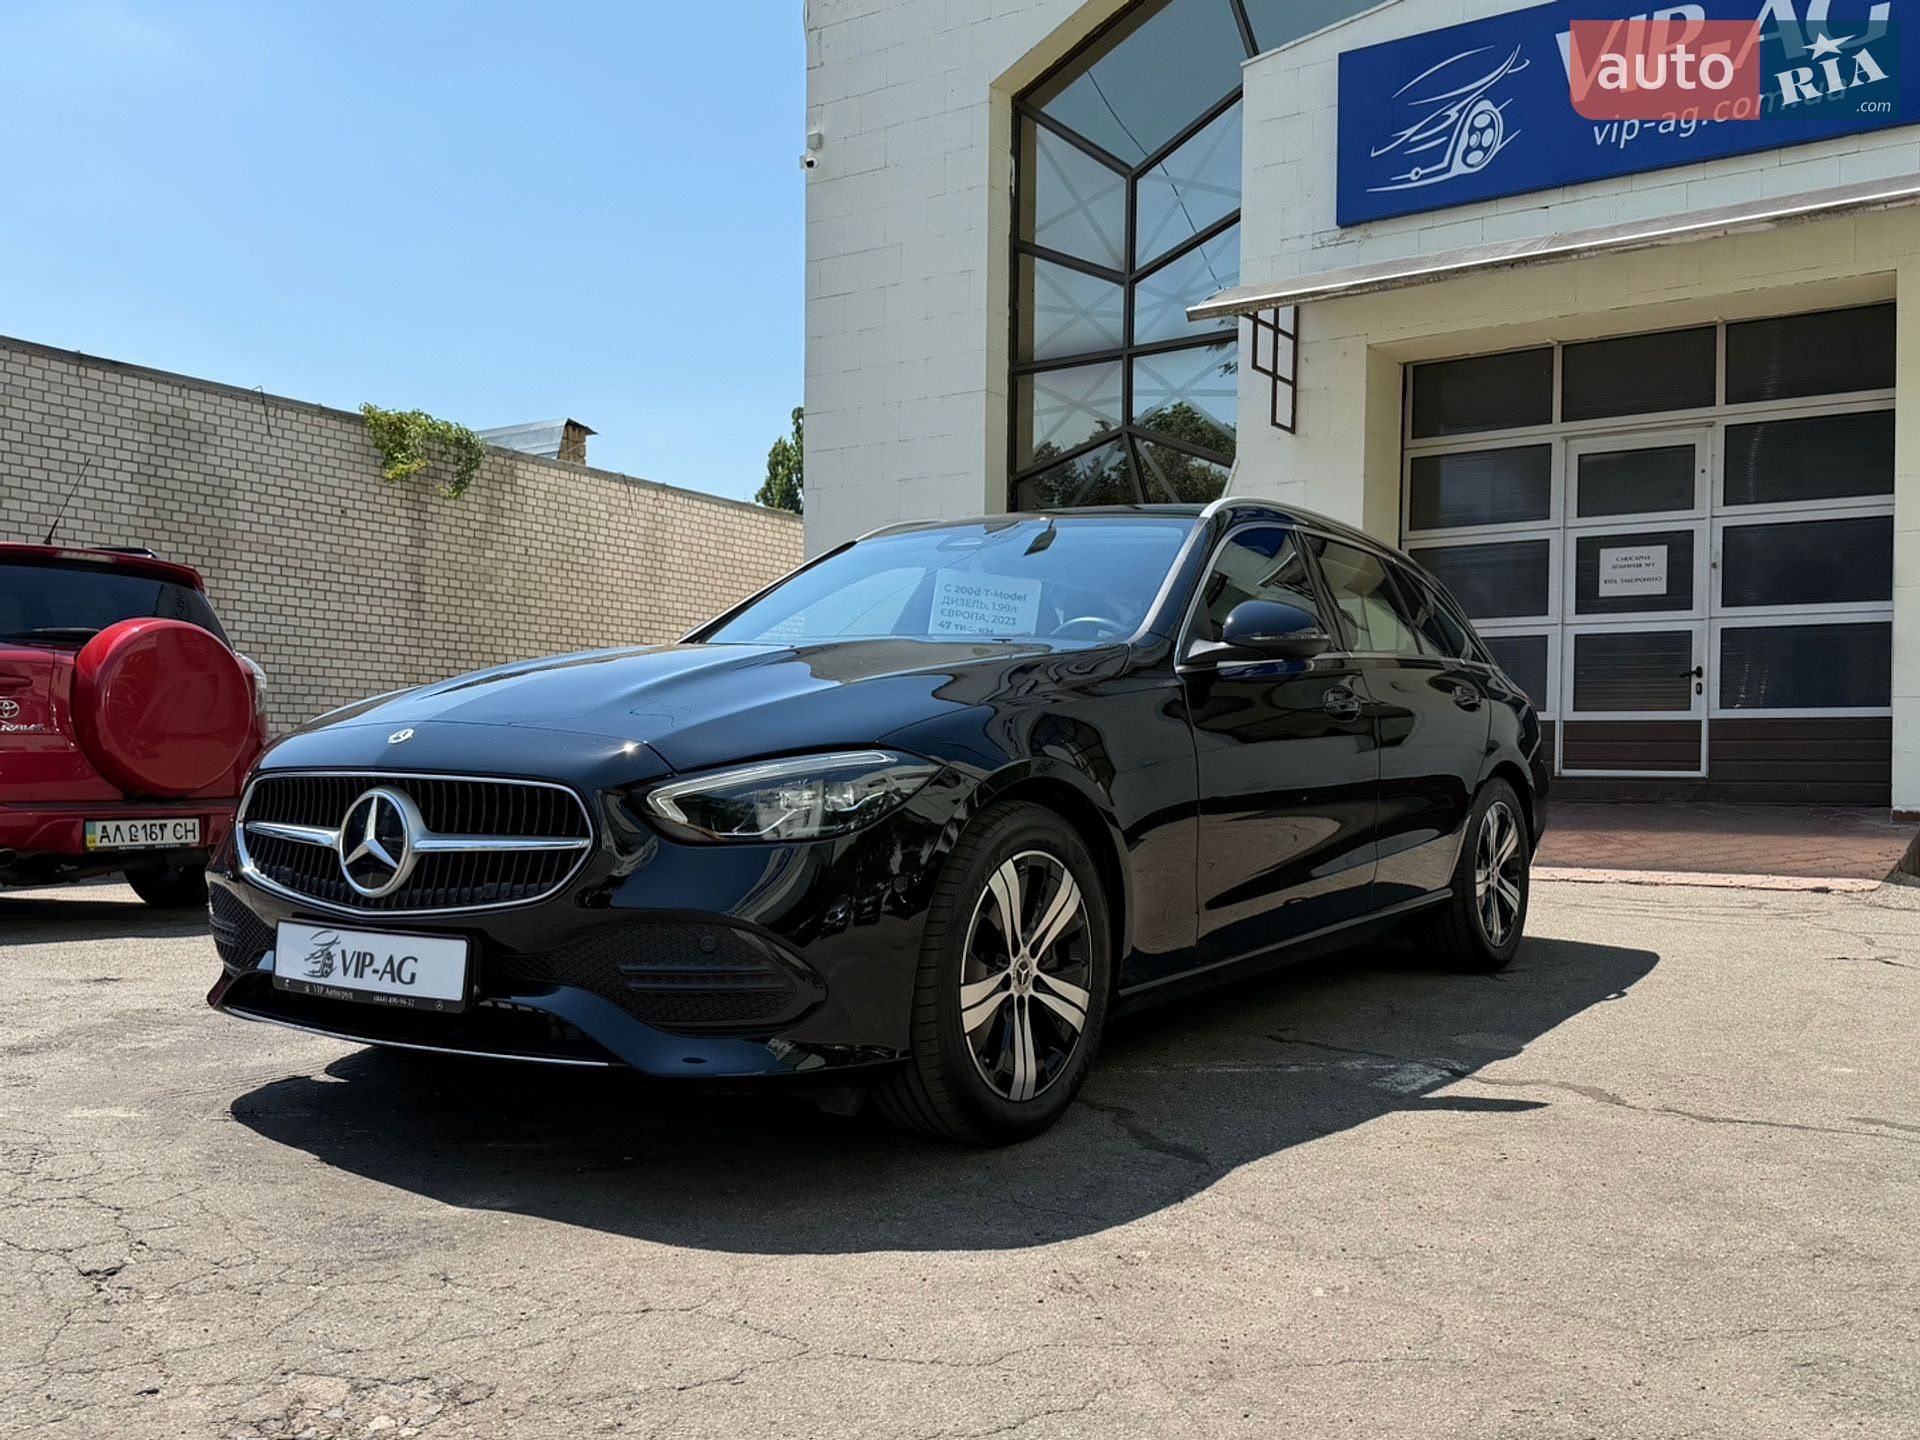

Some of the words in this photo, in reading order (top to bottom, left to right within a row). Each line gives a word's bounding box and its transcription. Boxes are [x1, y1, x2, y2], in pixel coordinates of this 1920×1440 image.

[1555, 0, 1892, 103] VIP-AG
[954, 585, 981, 597] 200d
[984, 589, 1027, 602] T-Model
[938, 620, 951, 630] 47
[992, 613, 1017, 626] 2023
[340, 949, 418, 985] VIP-AG
